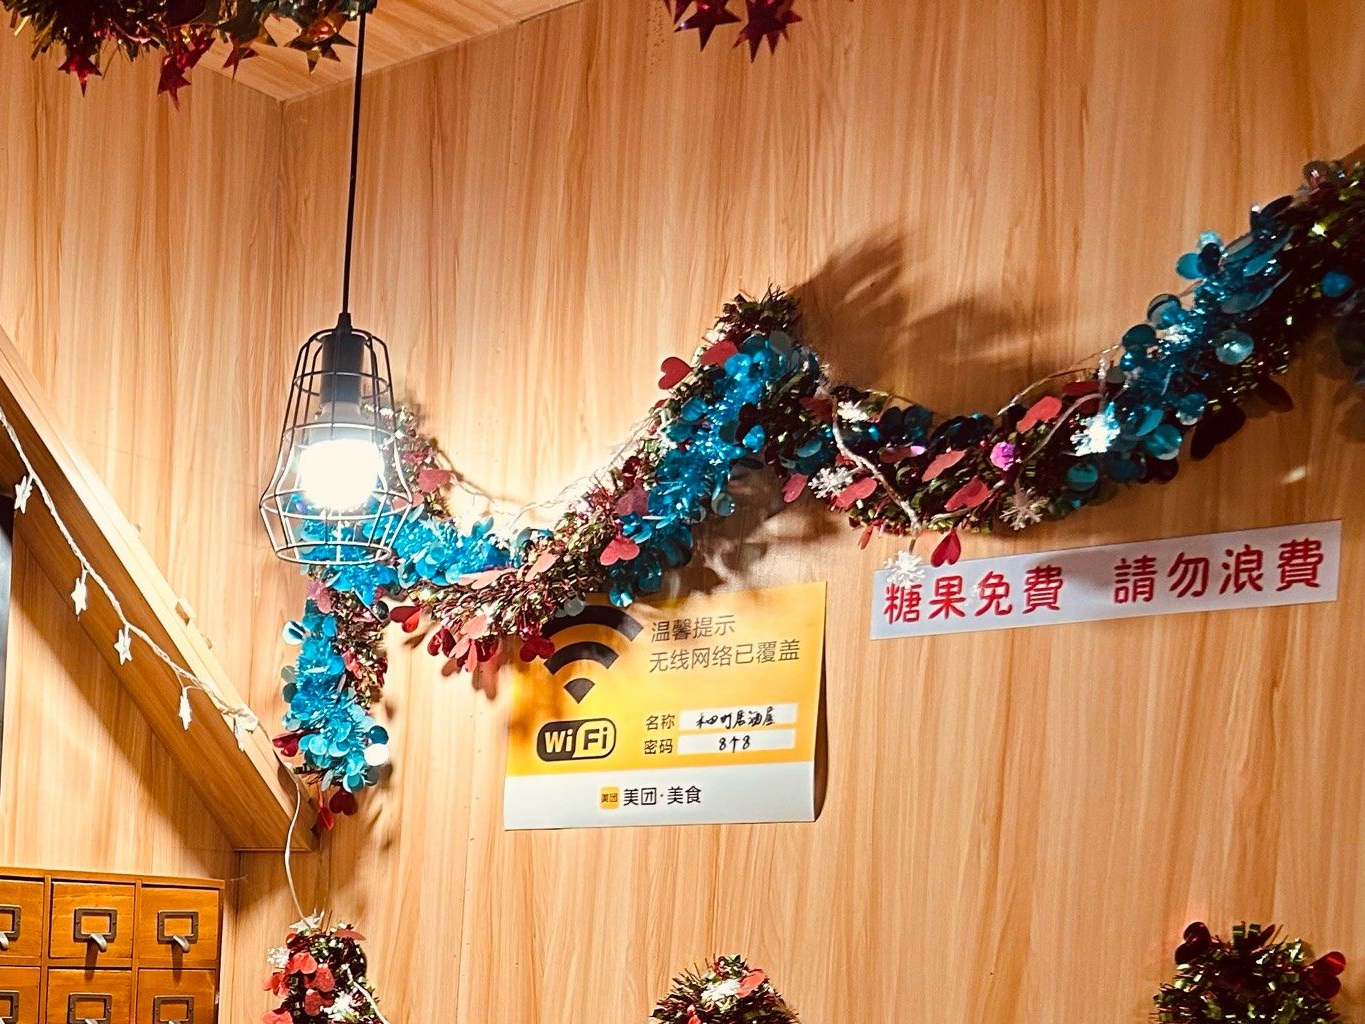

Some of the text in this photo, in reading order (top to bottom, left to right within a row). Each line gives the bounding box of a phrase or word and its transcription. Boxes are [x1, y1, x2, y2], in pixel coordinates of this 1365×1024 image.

[883, 538, 1325, 625] 糖果免費 請勿浪費
[651, 614, 736, 643] 温馨提示
[649, 638, 801, 673] 无线网络已覆盖
[645, 713, 676, 731] 名称
[544, 726, 609, 754] WiFi
[643, 738, 674, 755] 密码
